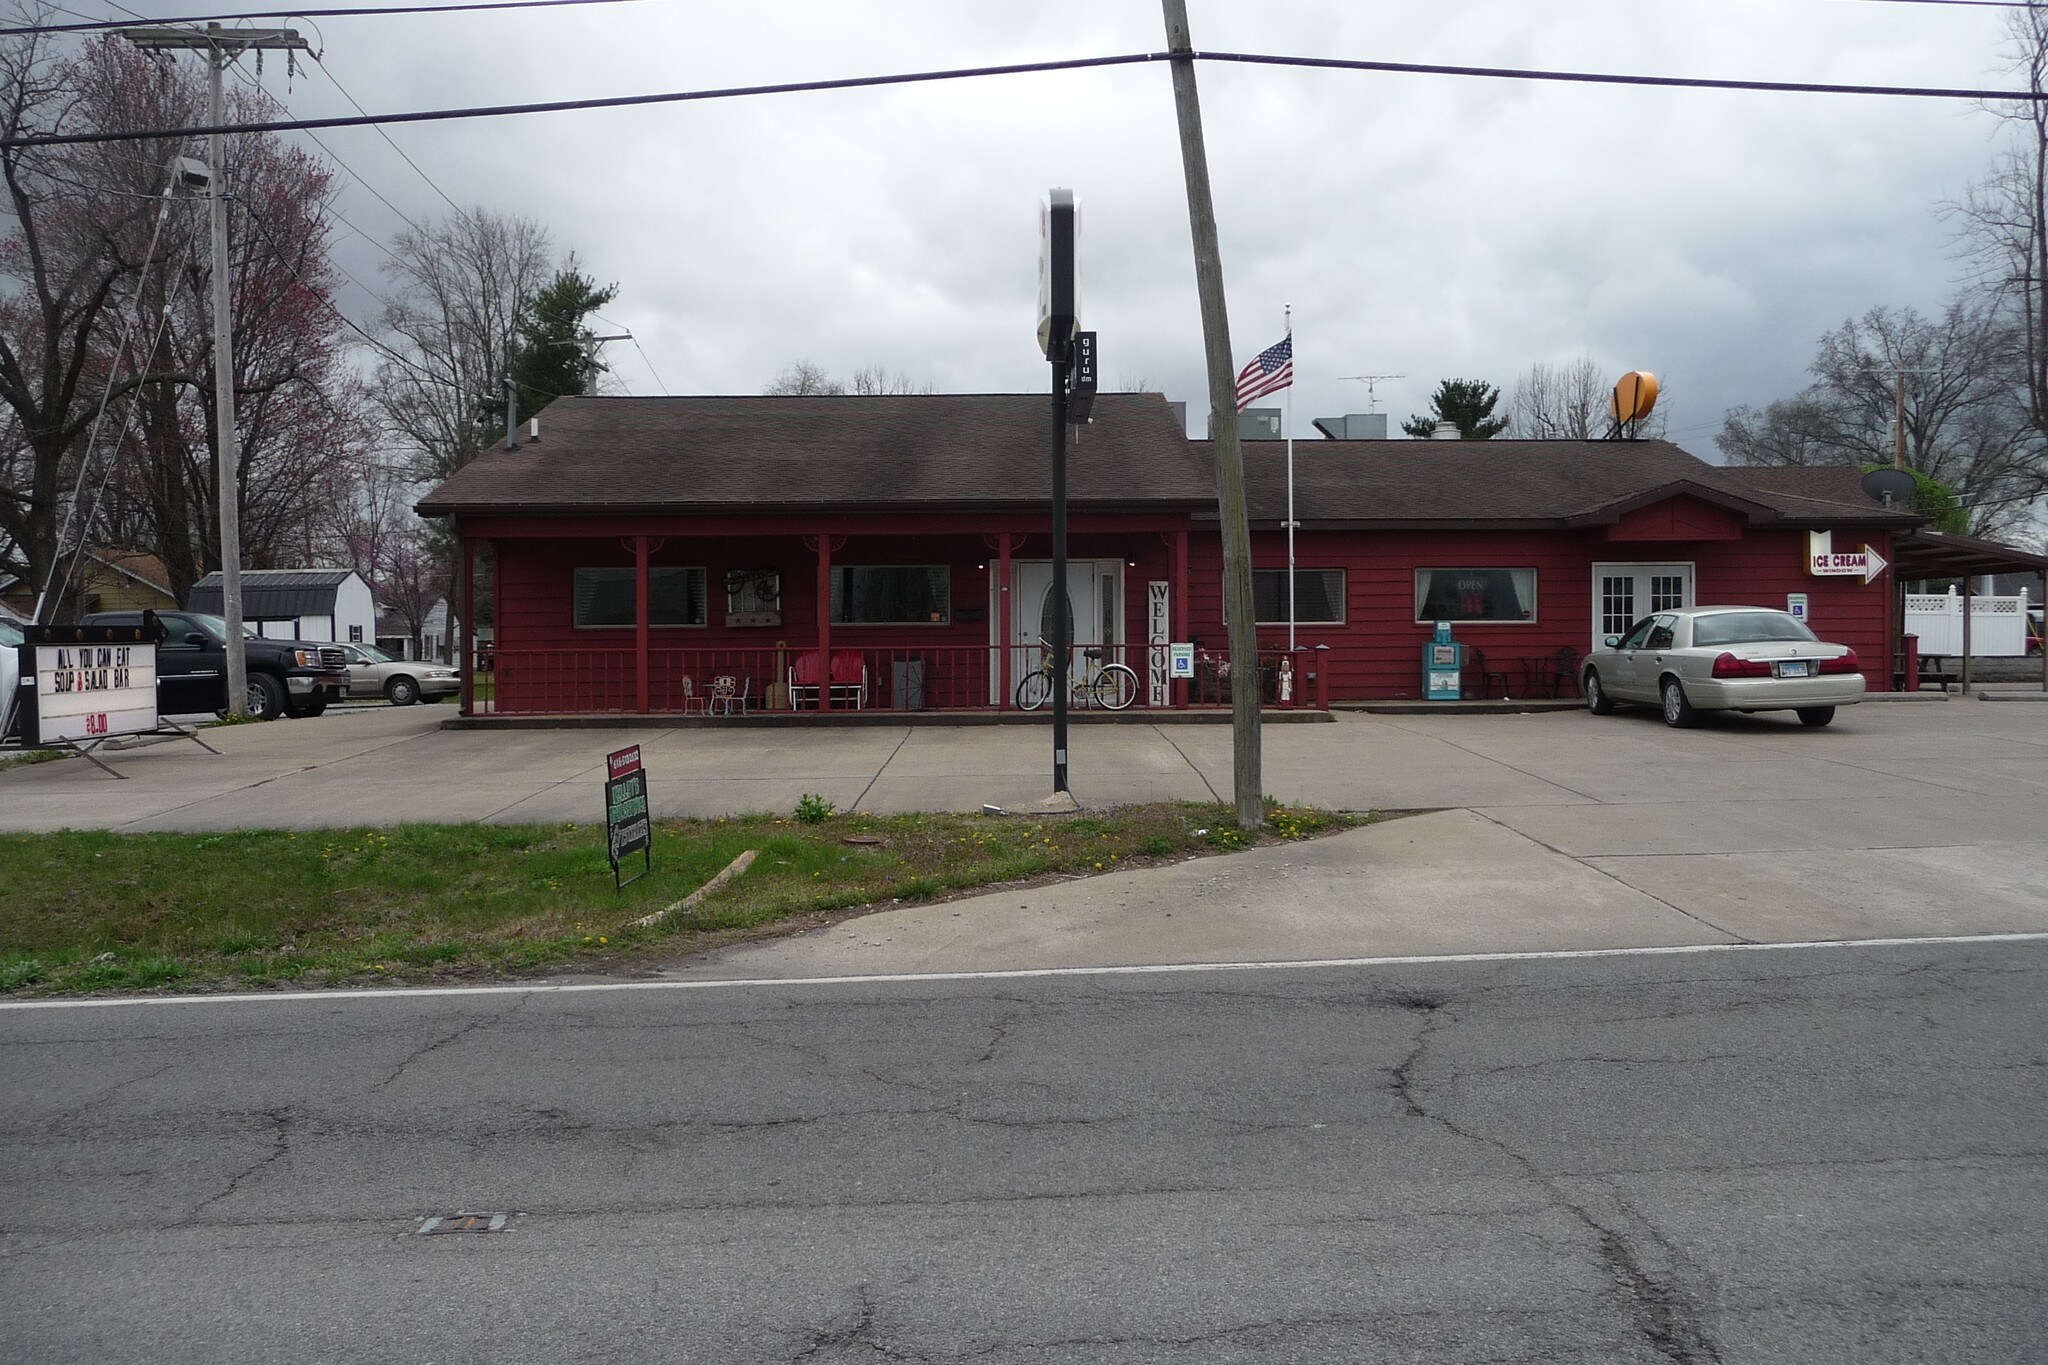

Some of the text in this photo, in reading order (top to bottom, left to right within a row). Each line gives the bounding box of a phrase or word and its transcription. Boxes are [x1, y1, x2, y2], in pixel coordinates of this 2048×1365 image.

[1813, 555, 1867, 568] ICE CREAM
[1458, 580, 1483, 590] OPEN
[1149, 585, 1168, 702] WELCOME
[57, 647, 130, 669] ALL YOU CAN EAT
[54, 671, 74, 693] SOUP
[85, 669, 108, 690] SALAD
[114, 668, 130, 688] BAR
